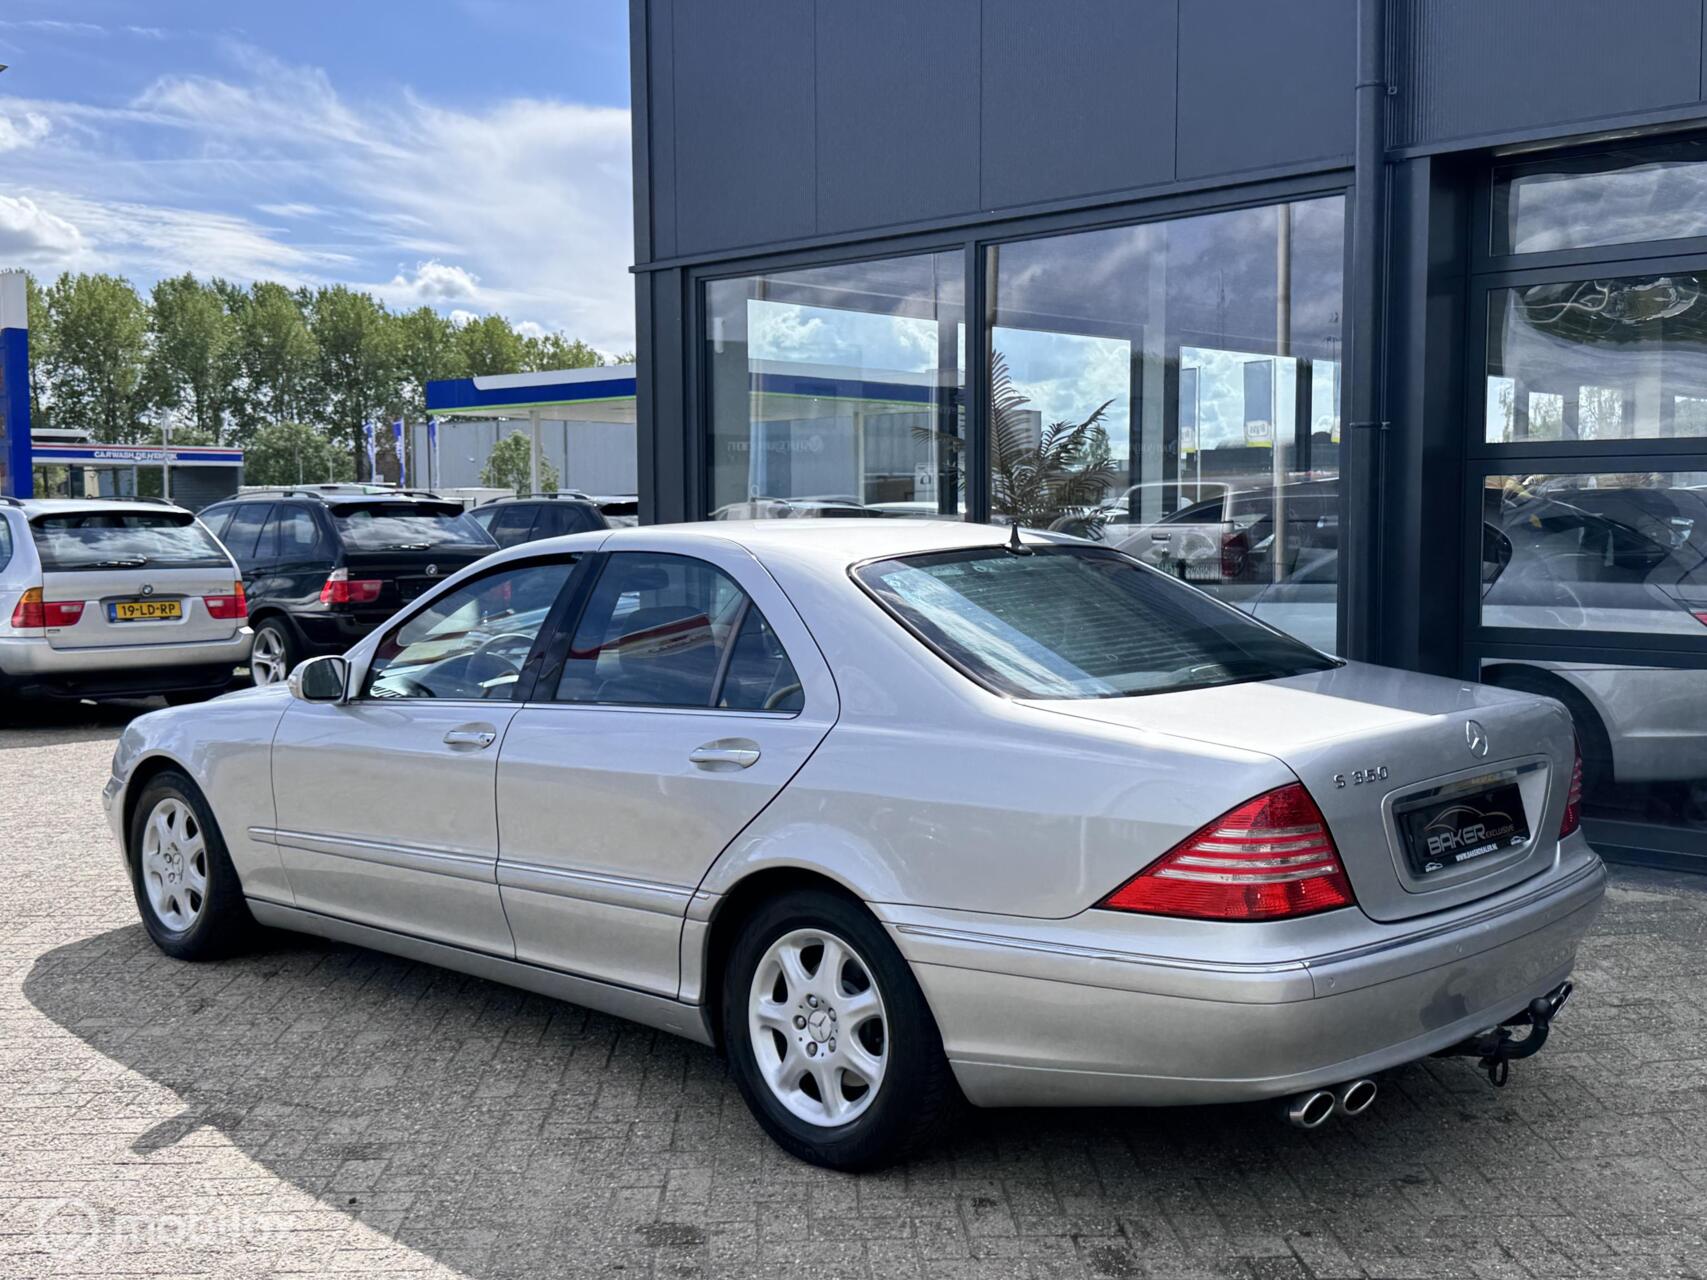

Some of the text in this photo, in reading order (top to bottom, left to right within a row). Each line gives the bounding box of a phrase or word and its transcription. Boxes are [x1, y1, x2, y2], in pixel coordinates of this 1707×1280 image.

[94, 450, 134, 459] CARWASH
[121, 603, 176, 617] 19-LD-RP
[1333, 766, 1388, 789] S 350
[1426, 823, 1486, 855] BAKER
